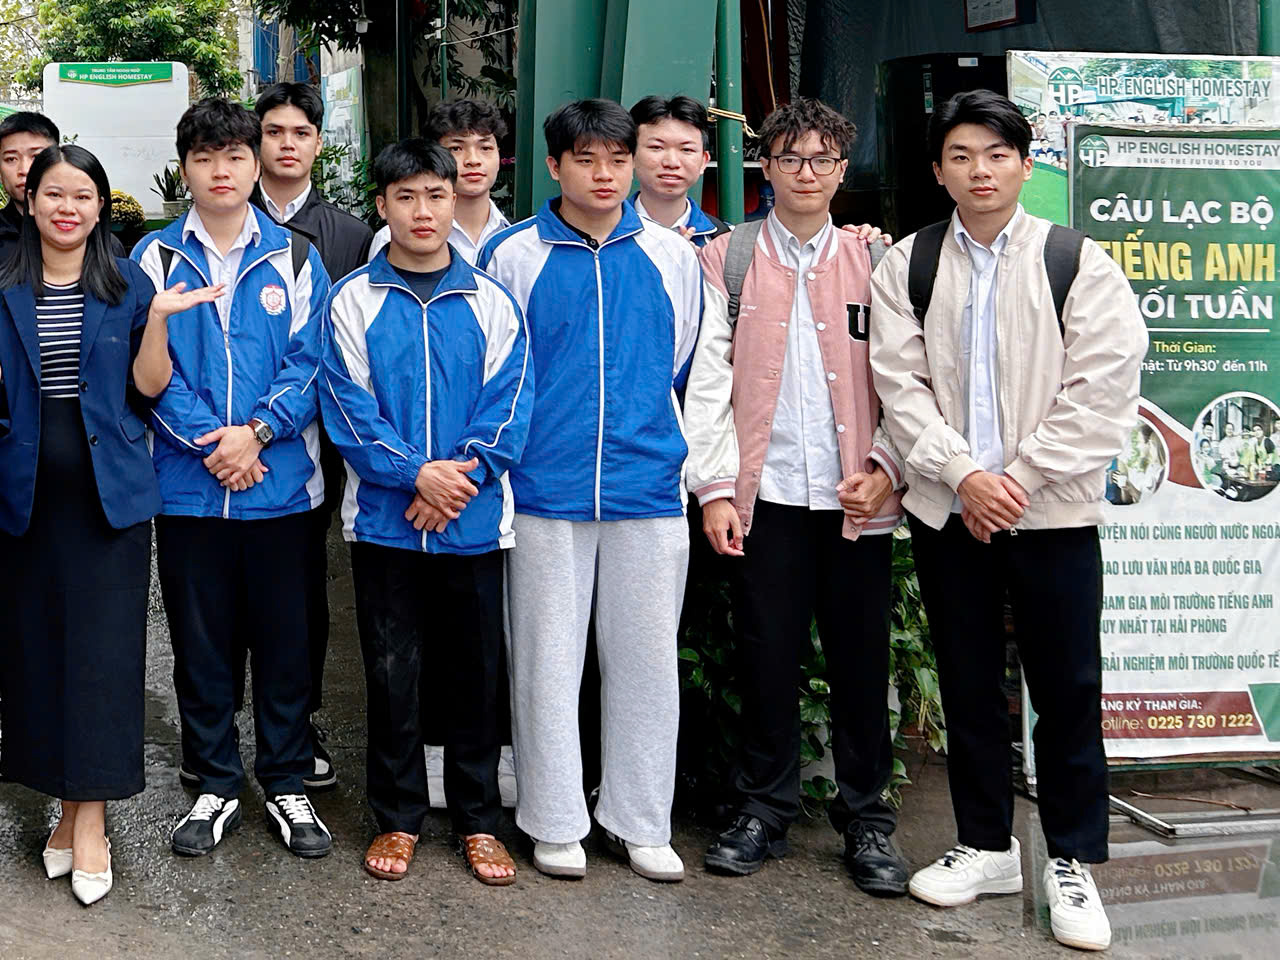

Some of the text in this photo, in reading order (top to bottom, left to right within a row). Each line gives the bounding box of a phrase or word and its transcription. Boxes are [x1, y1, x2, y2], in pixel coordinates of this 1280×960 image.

[1048, 84, 1083, 106] HP
[1099, 77, 1271, 98] HP ENGLISH HOMESTAY
[1079, 149, 1109, 167] HP
[1117, 141, 1280, 157] HP ENGLISH HOMESTAY
[1137, 157, 1166, 165] BRING
[1190, 158, 1225, 166] FUTURE
[1090, 193, 1274, 231] CÂU LẠC BỘ
[1205, 243, 1276, 282] ANH
[1184, 286, 1273, 320] TUẦN
[1153, 341, 1217, 353] Thời Gian:
[1140, 359, 1165, 374] hật:
[1166, 360, 1182, 371] Từ
[1222, 359, 1246, 371] đến
[1248, 360, 1268, 371] 11h
[1099, 521, 1280, 543] UYỆN NÓI CÙNG NGƯỜI NƯỚC NGOÀ
[1122, 559, 1143, 575] LƯU
[1146, 557, 1167, 575] VĂN
[1170, 557, 1192, 575] HÓA
[1194, 560, 1209, 575] ĐA
[1212, 554, 1240, 576] QUỐC
[1243, 560, 1262, 575] GIA
[1103, 590, 1273, 610] HAM GIA MÔI TRƯỜNG TIẾNG ANH
[1100, 613, 1227, 637] UY NHẤT TẠI HẢI PHÒNG
[1101, 649, 1280, 674] RẢI NGHIỆM MÔI TRƯỜNG QUỐC TẾ
[1101, 698, 1202, 711] ĂNG KÝ THAM GIA:
[1101, 713, 1253, 730] otline: 0225 730 1222
